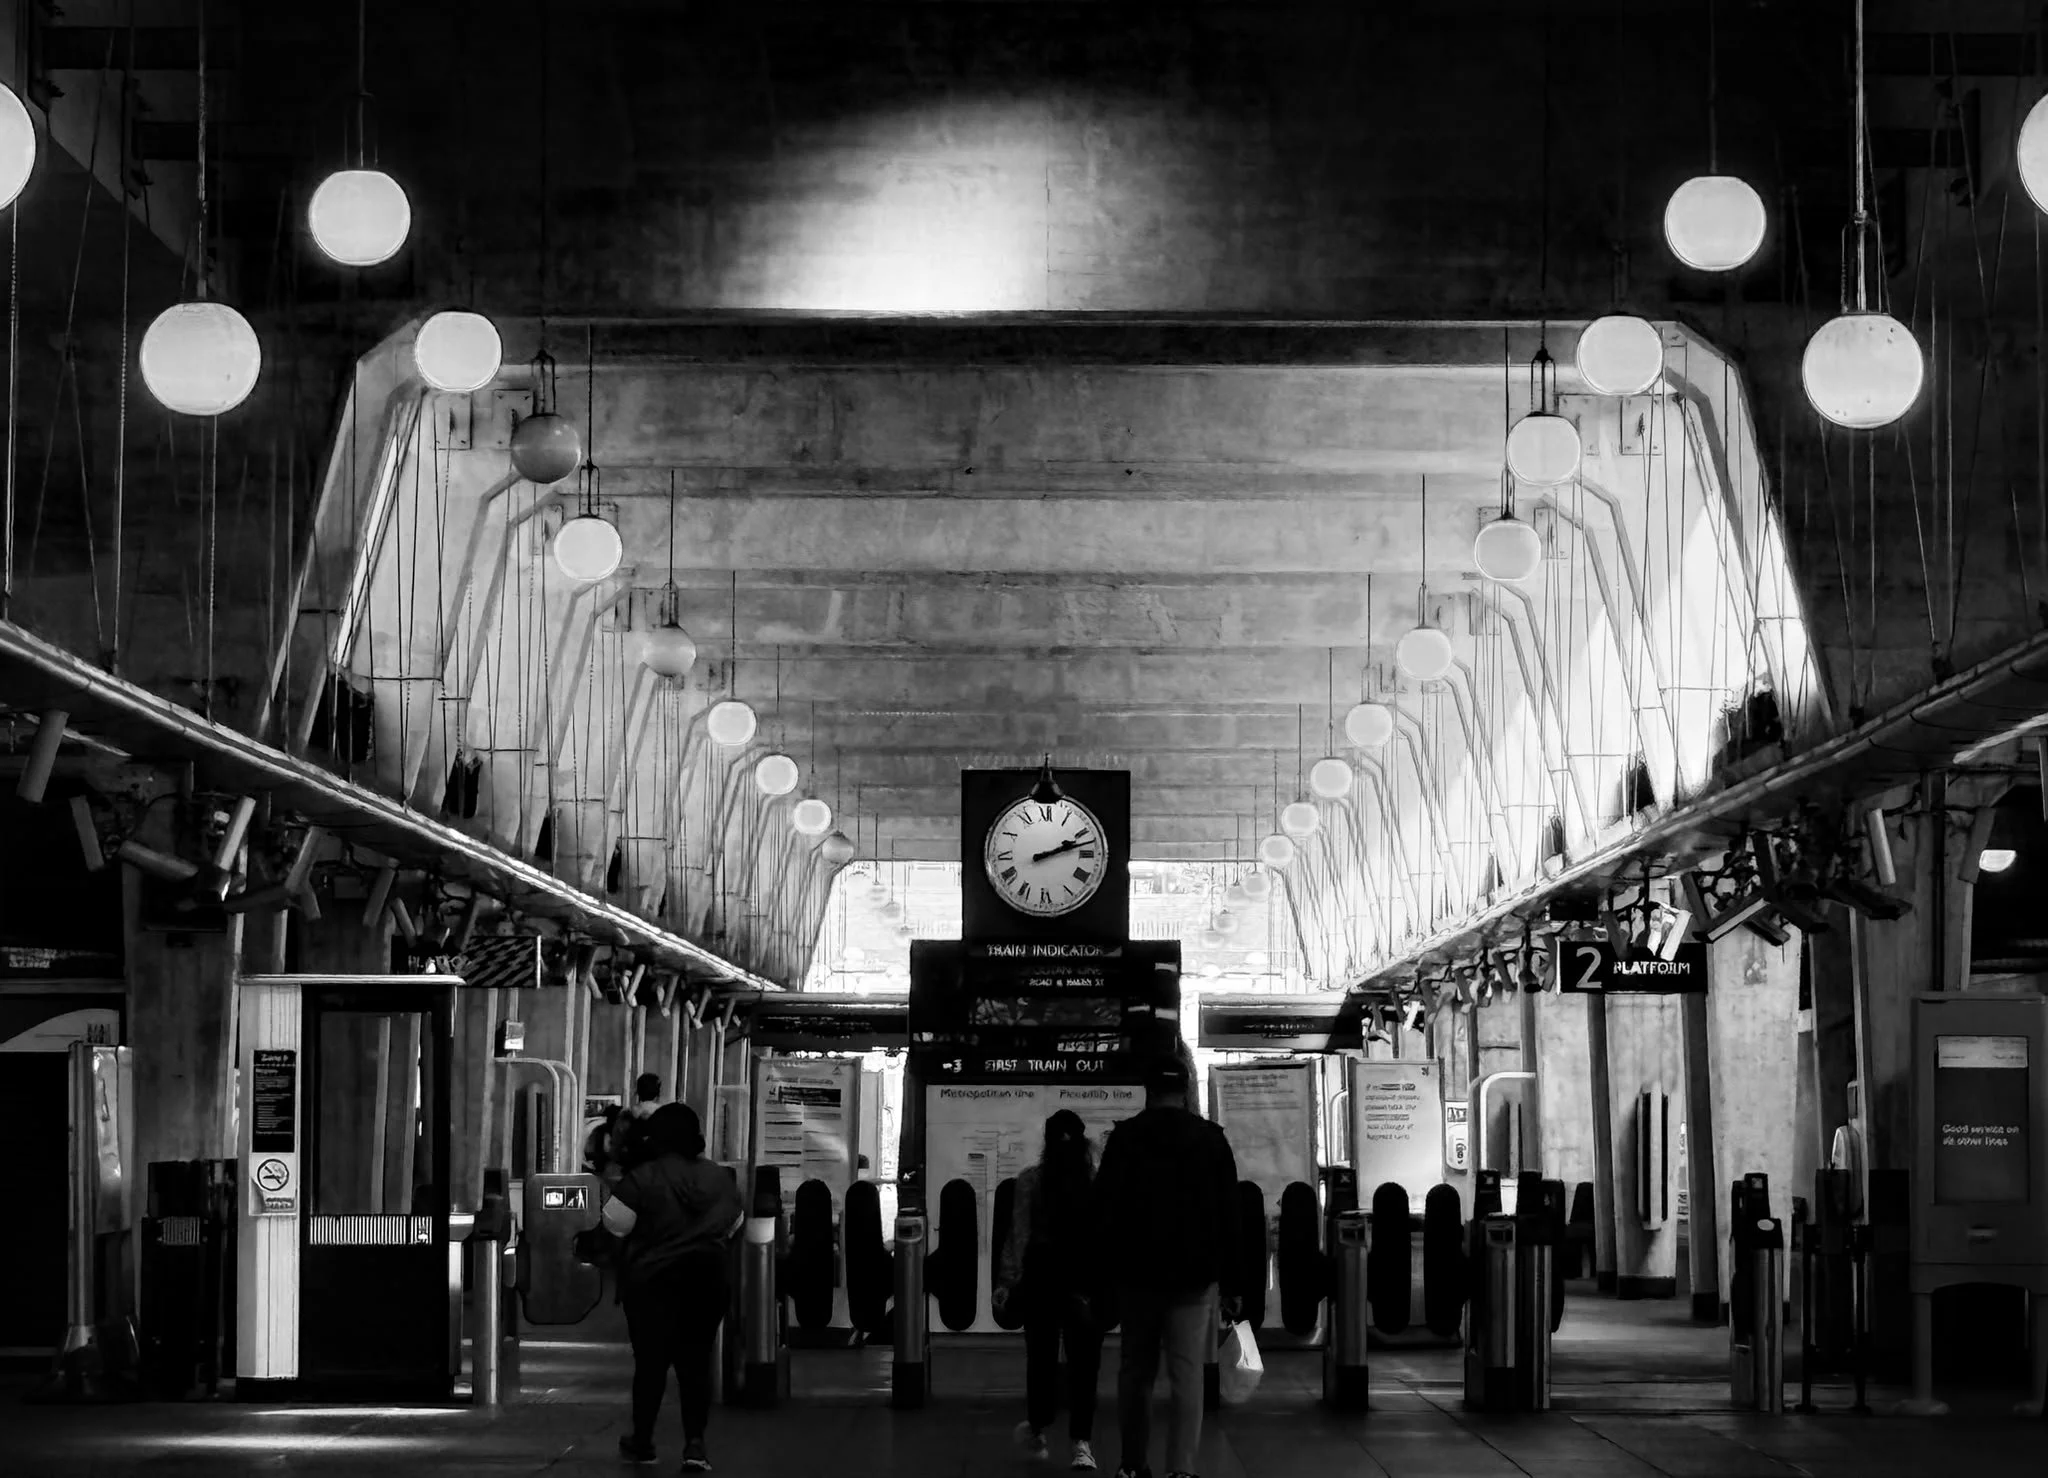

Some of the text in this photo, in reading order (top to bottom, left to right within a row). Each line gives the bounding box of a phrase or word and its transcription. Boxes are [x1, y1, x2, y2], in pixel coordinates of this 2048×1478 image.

[987, 943, 1104, 957] TRAIN INDICATOR
[1575, 946, 1691, 989] 2 PLATFORM
[984, 1058, 1018, 1073] FIRST
[1028, 1058, 1067, 1073] TRAIN
[1076, 1058, 1105, 1073] OUT
[940, 1089, 1010, 1101] Metropolitan
[1059, 1089, 1109, 1102] Piccadilly
[1942, 1124, 1969, 1134] Good
